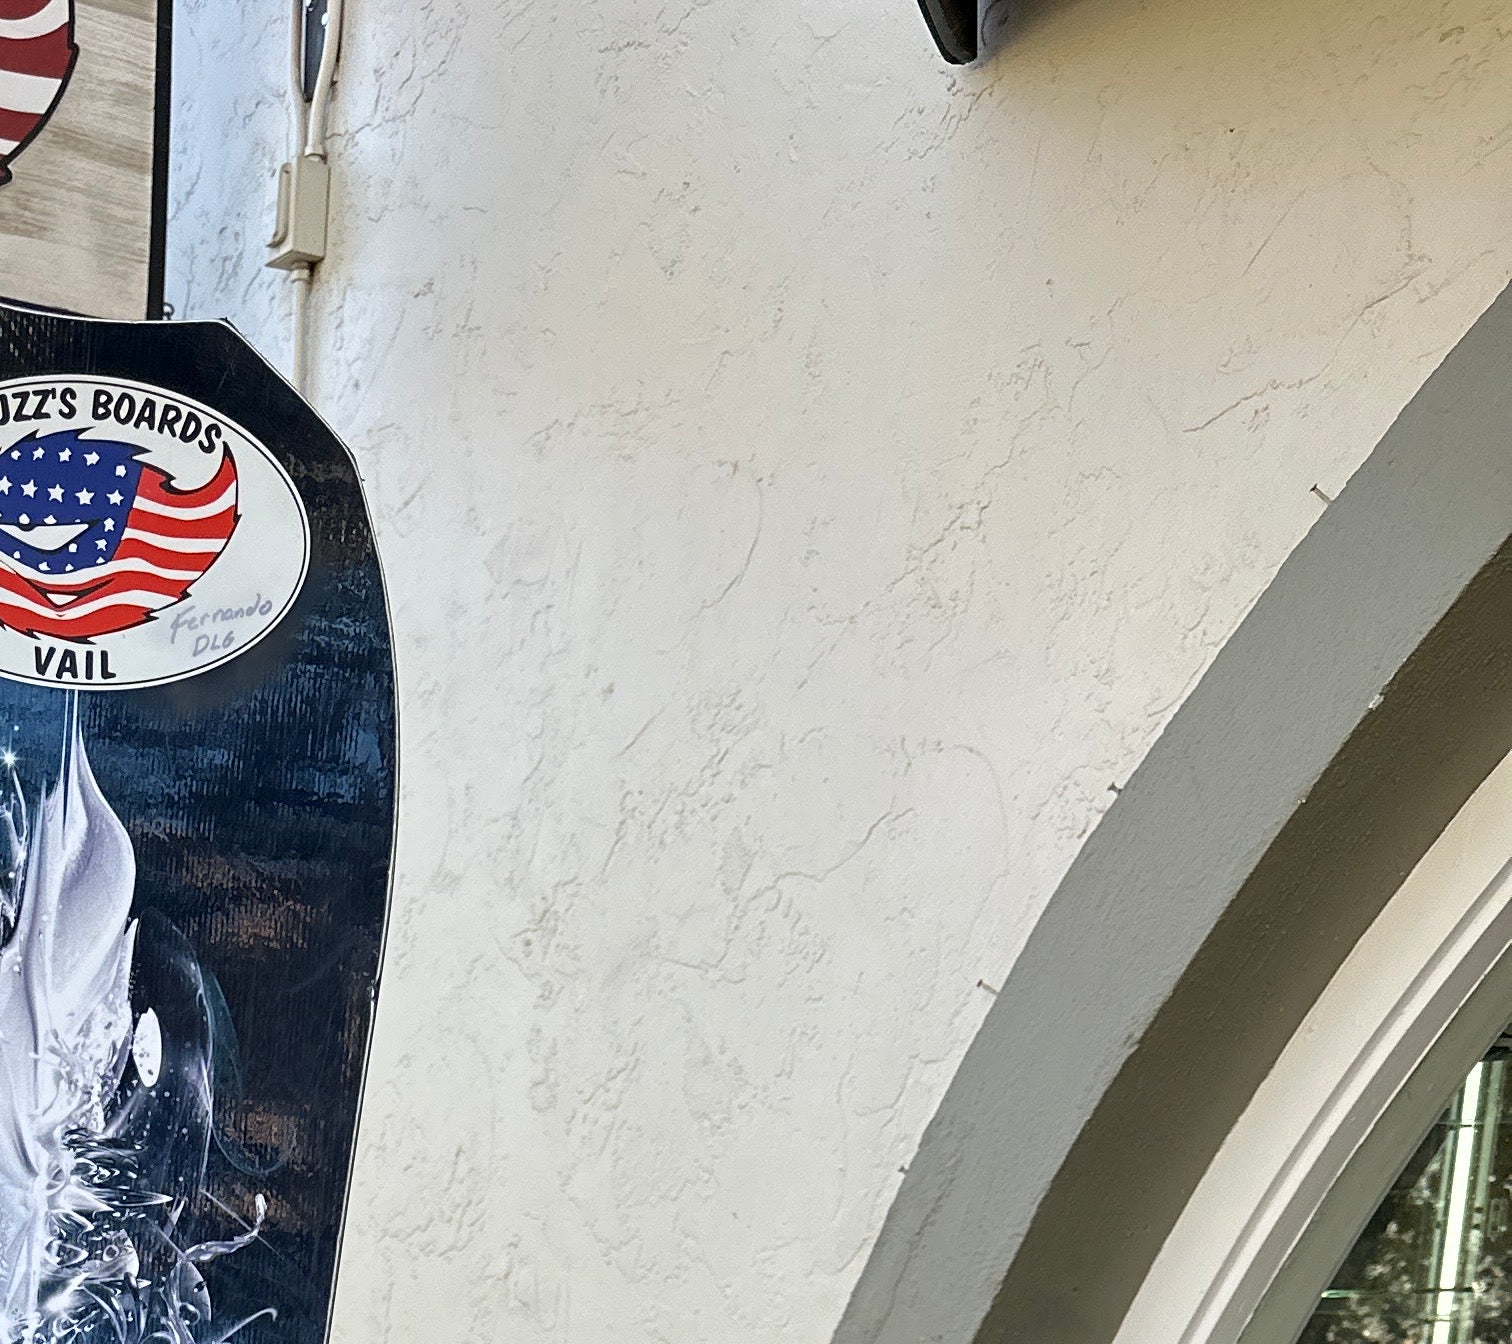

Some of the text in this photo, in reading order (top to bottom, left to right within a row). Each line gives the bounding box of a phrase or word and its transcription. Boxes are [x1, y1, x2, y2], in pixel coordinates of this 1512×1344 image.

[91, 389, 222, 454] BOARDS
[170, 592, 273, 645] Fernando
[33, 645, 118, 681] VAIL
